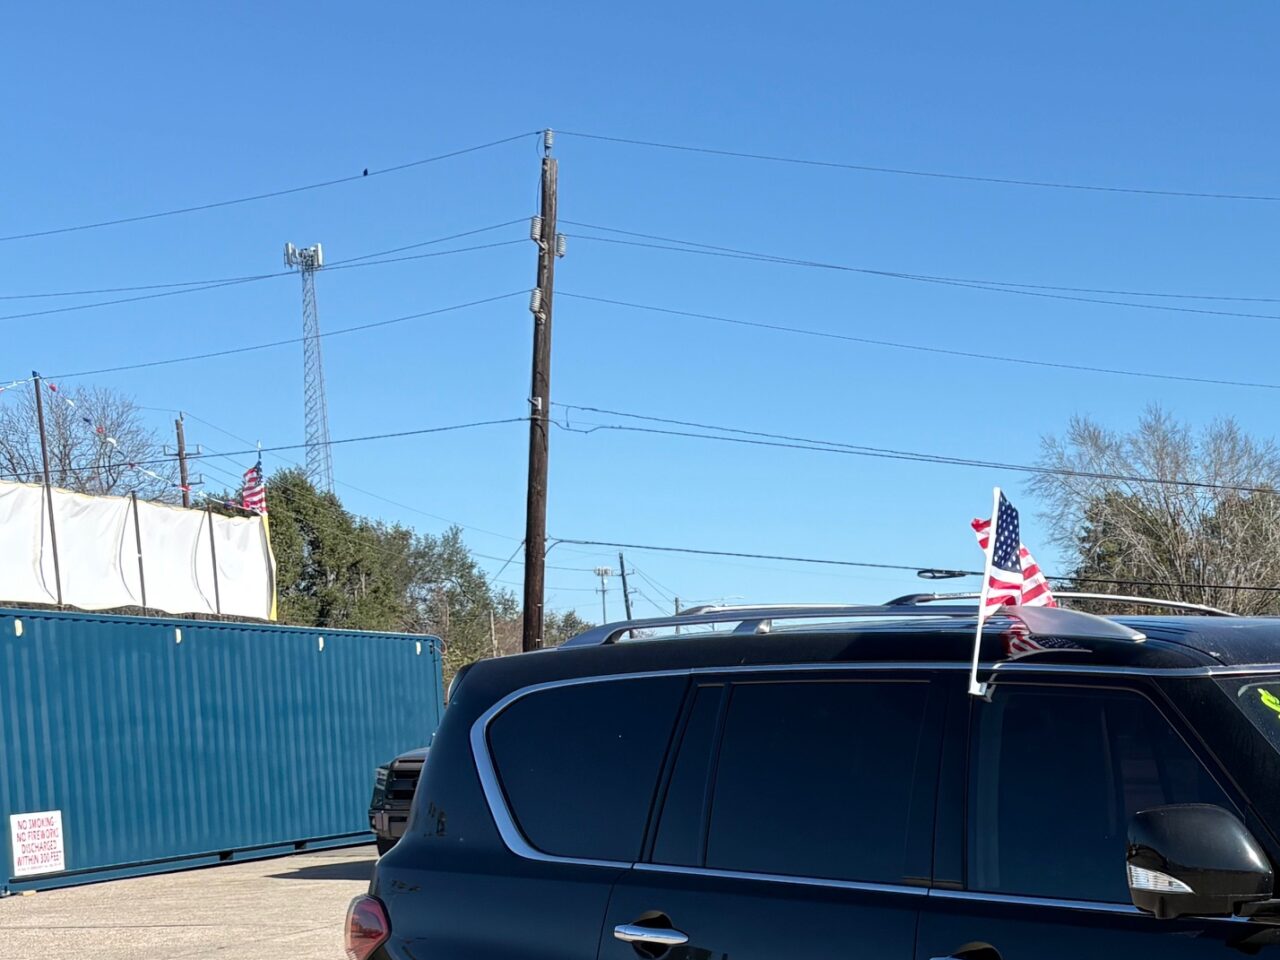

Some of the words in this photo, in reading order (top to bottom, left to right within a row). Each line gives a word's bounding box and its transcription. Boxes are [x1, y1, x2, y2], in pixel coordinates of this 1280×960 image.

[17, 819, 27, 830] NO
[28, 816, 54, 829] SMOKING
[16, 831, 26, 842] NO
[17, 855, 39, 867] WITHIN
